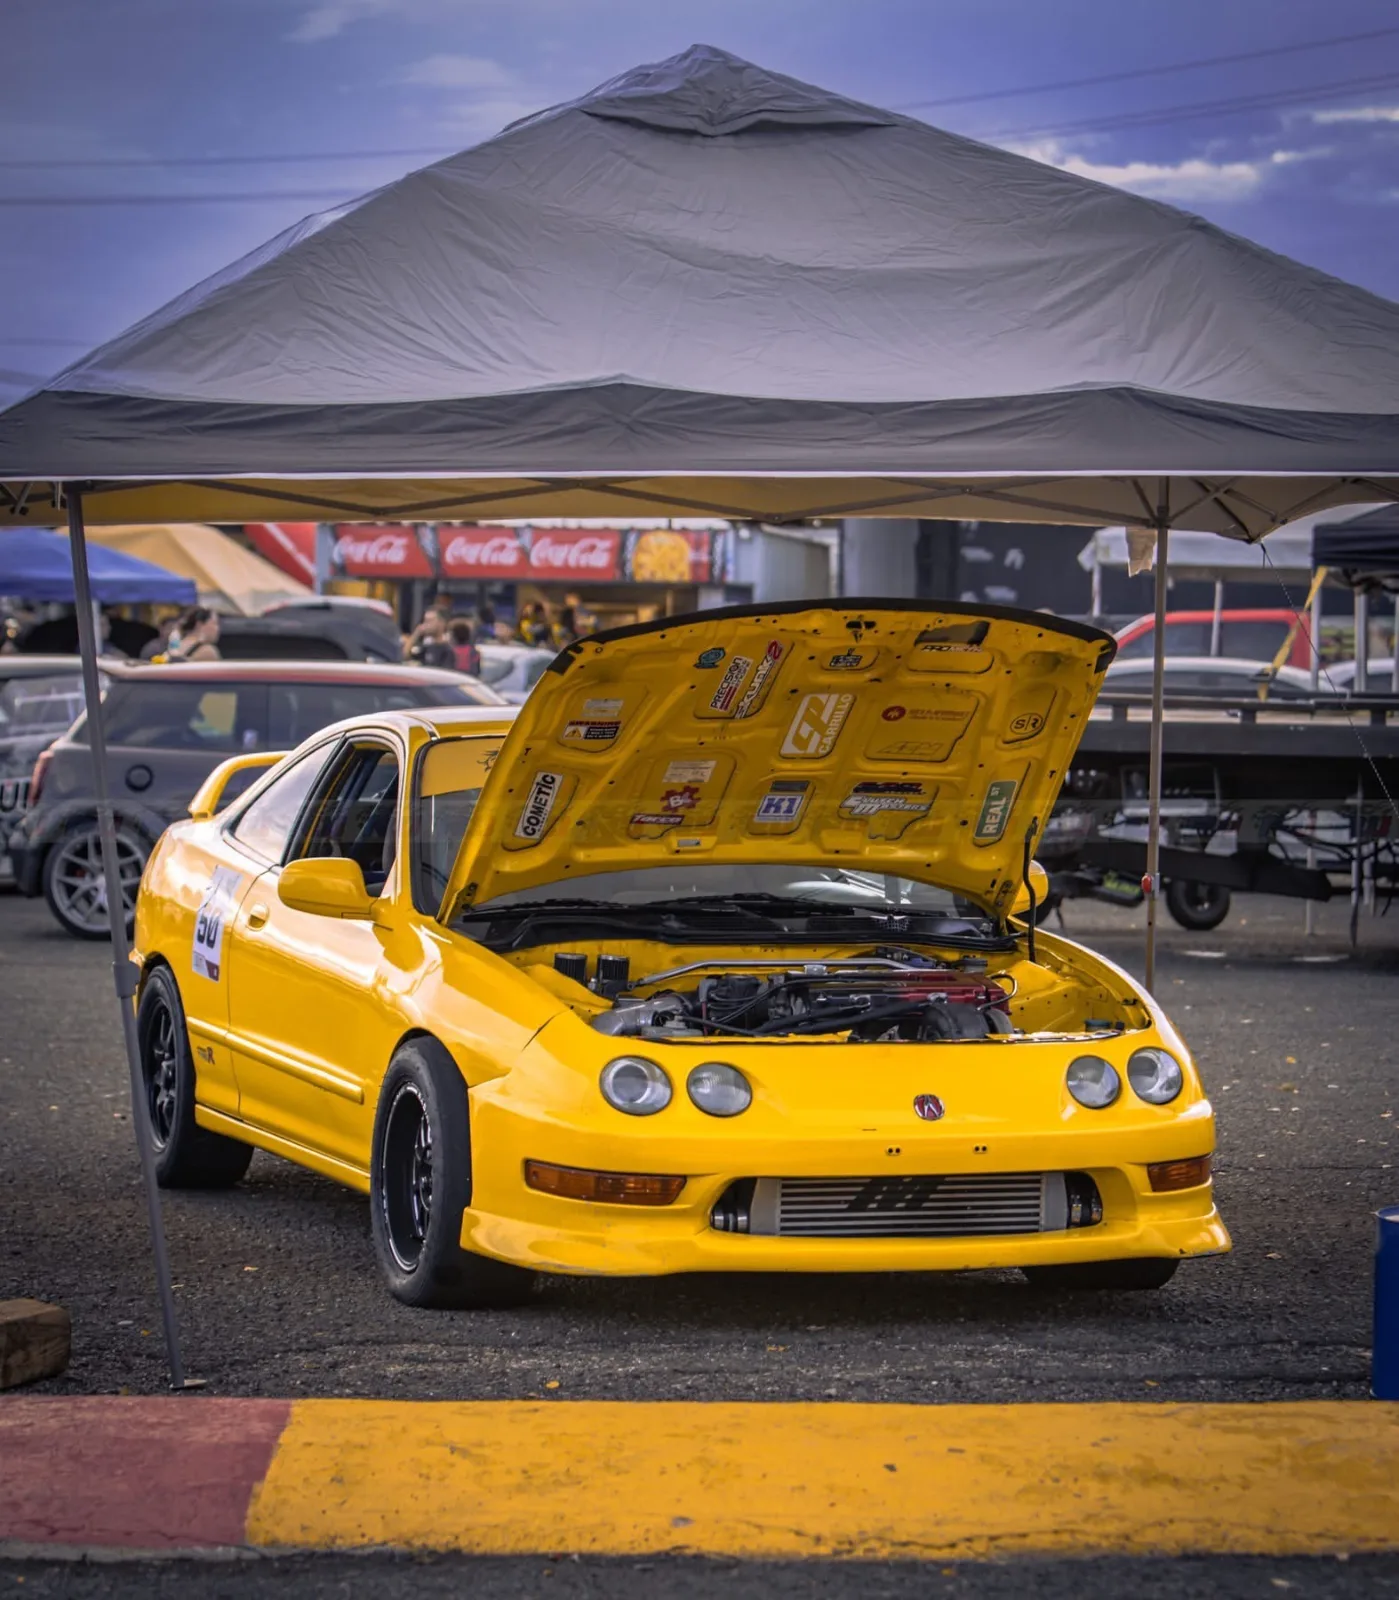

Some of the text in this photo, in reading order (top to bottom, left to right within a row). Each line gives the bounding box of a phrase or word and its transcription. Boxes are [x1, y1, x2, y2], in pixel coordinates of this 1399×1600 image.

[819, 693, 853, 755] CARRILLO
[523, 774, 556, 837] COMETIC
[982, 797, 1007, 834] REAL
